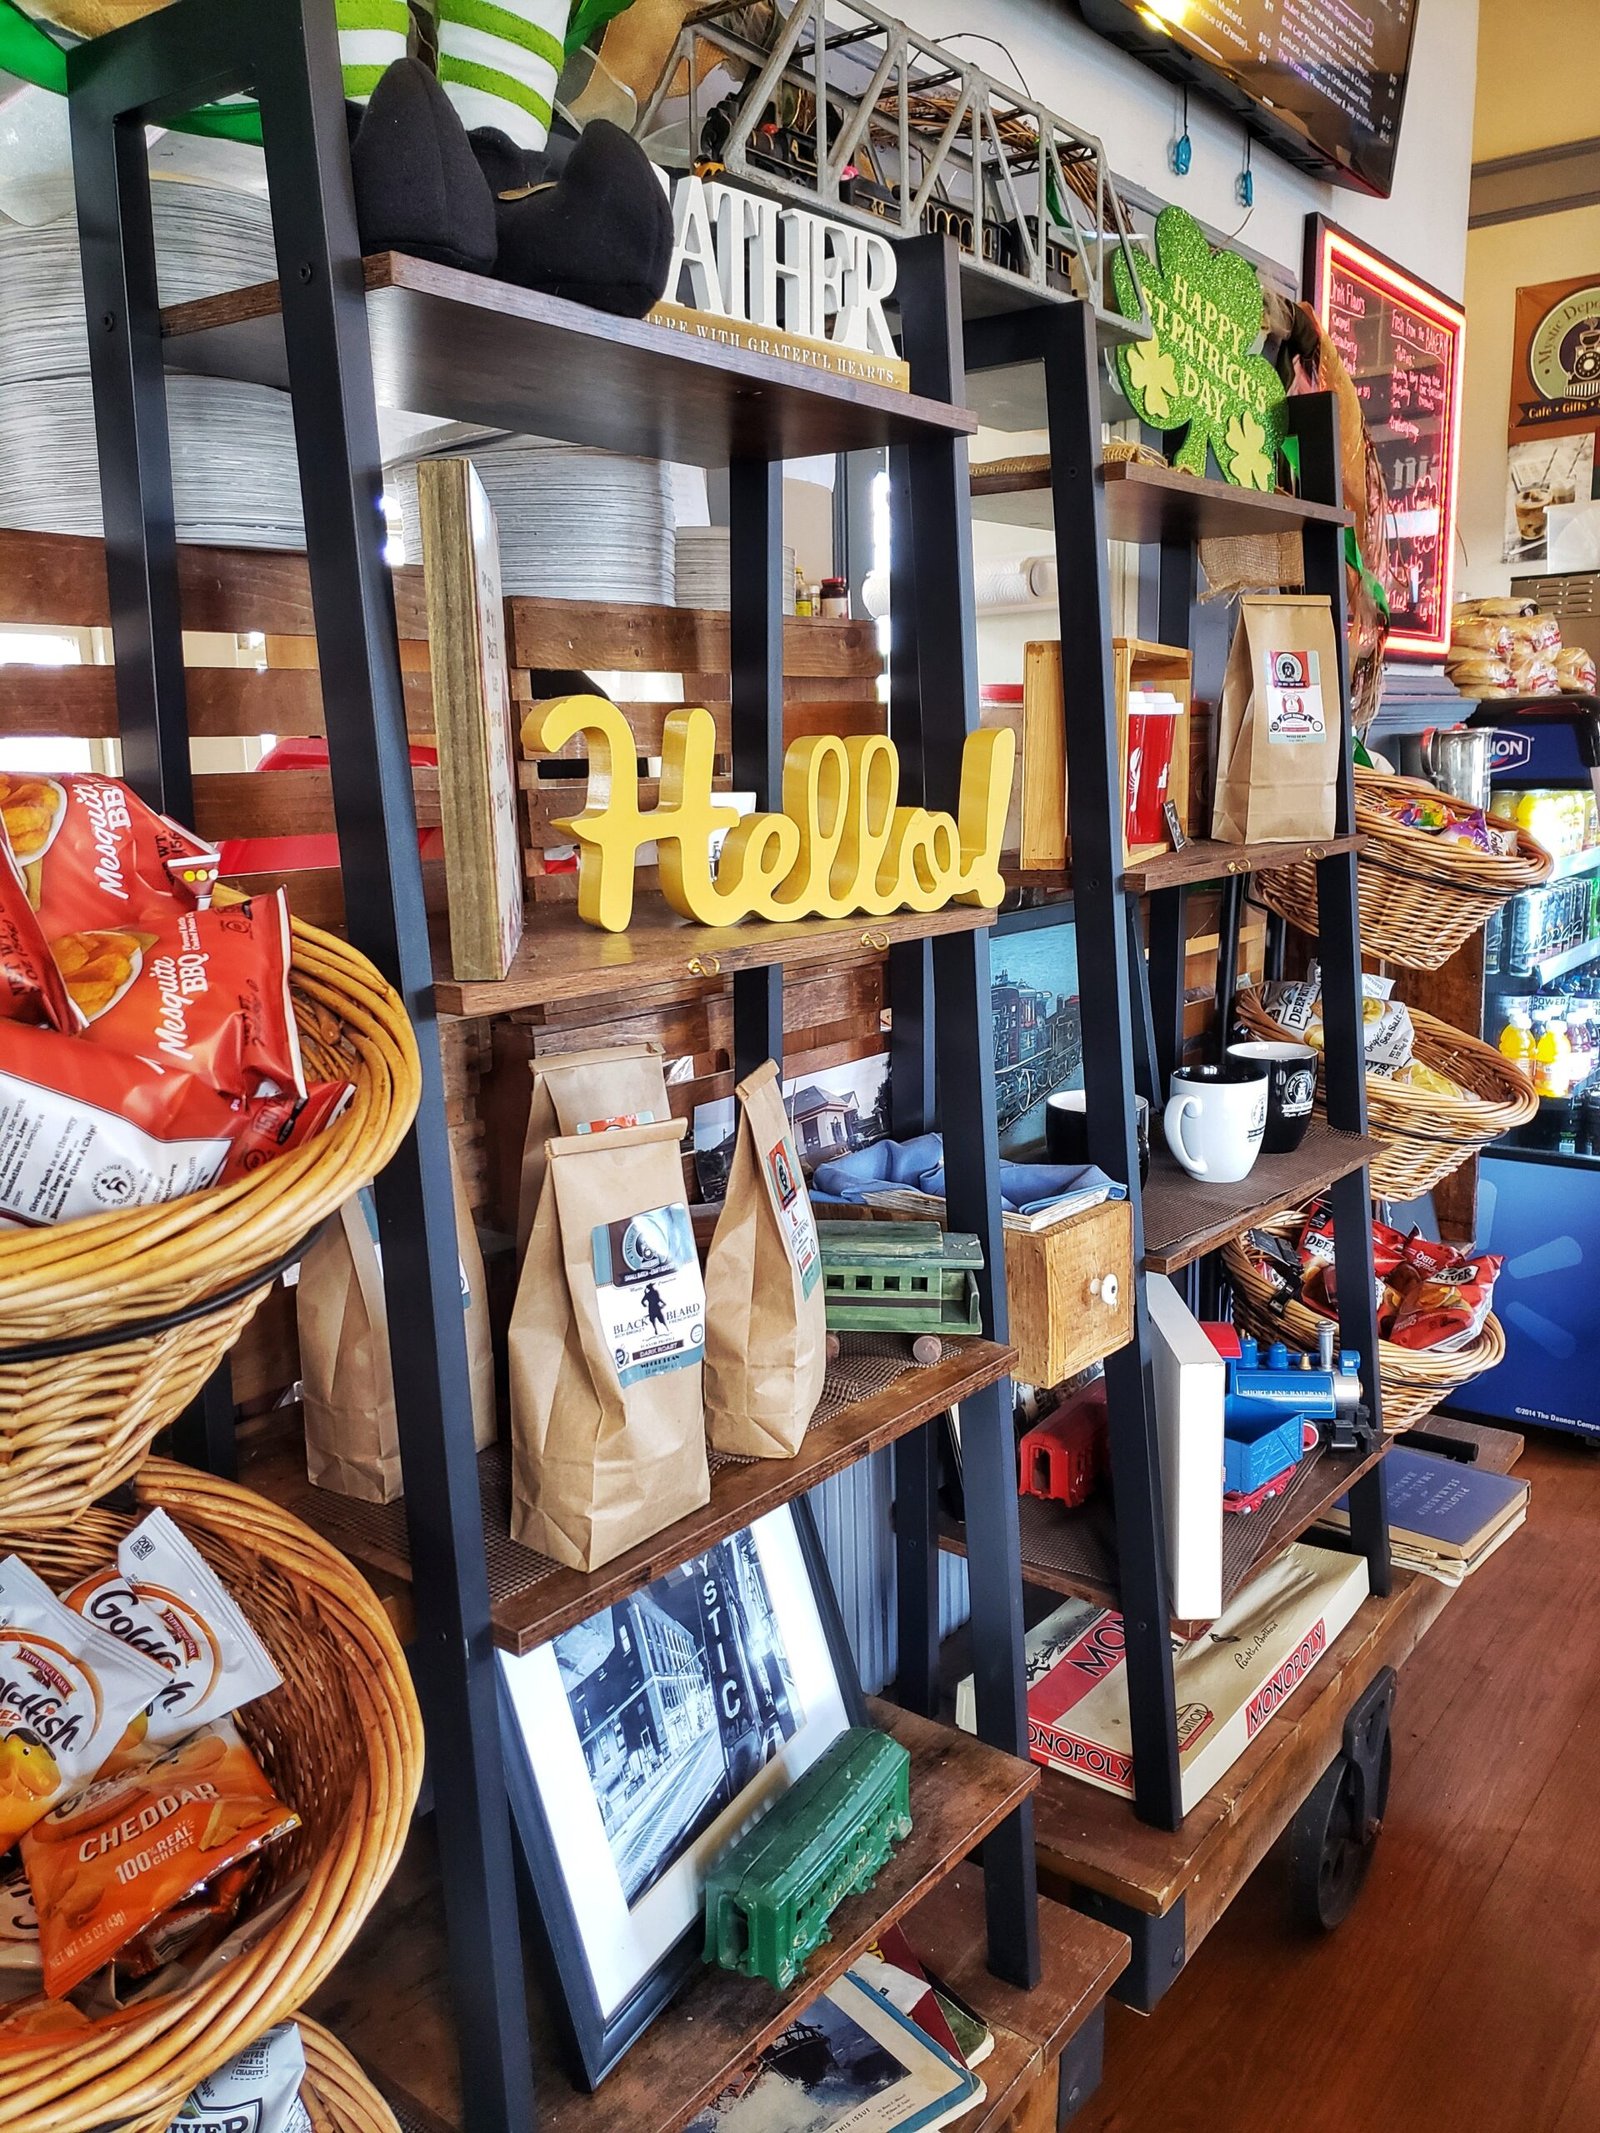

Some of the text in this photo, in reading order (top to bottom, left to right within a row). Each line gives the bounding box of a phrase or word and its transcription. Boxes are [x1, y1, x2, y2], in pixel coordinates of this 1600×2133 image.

[650, 161, 901, 361] ATHER
[1173, 273, 1245, 356] HAPPY
[696, 325, 741, 348] WITH
[748, 337, 832, 370] GRATEFUL
[837, 358, 900, 384] HEARTS.
[1170, 312, 1267, 414] PATRICK'S
[1538, 319, 1563, 366] Mystic
[1182, 364, 1228, 423] DAY
[1562, 400, 1587, 414] Gifts
[520, 694, 1016, 933] Hello!
[74, 782, 127, 900] Mesquit
[181, 954, 208, 993] BBQ
[152, 960, 193, 1058] Mesquite
[1379, 1014, 1402, 1045] Sea Salt
[1363, 1020, 1386, 1052] Original
[28, 1186, 46, 1213] Giving
[40, 1167, 54, 1186] Back
[49, 1172, 64, 1192] Deep
[59, 1148, 75, 1172] River
[49, 1188, 69, 1220] Because
[81, 1123, 98, 1148] Chip!
[1437, 1267, 1473, 1282] RIVER
[613, 1318, 649, 1335] BLACK
[640, 1342, 678, 1358] DARK ROAST
[1242, 1389, 1327, 1398] SHORT LINE RAILROAD
[1537, 1411, 1549, 1420] The
[1550, 1414, 1576, 1426] Dannon
[136, 1536, 153, 1552] 200
[183, 1637, 196, 1658] FARM
[698, 1553, 741, 1719] YSTIC
[20, 1649, 70, 1693] PEPPERIDGE FARM
[1250, 1624, 1324, 1735] MONOPOLY
[1183, 1709, 1206, 1737] EDITION
[1029, 1723, 1133, 1782] ONOPOLY
[78, 1778, 219, 1863] CHEDDAR
[155, 1825, 192, 1851] REAL
[152, 1836, 195, 1865] CHEESE
[47, 1910, 127, 1968] NET WT 1.5 OZ (43g)
[235, 2068, 265, 2076] CHARITY
